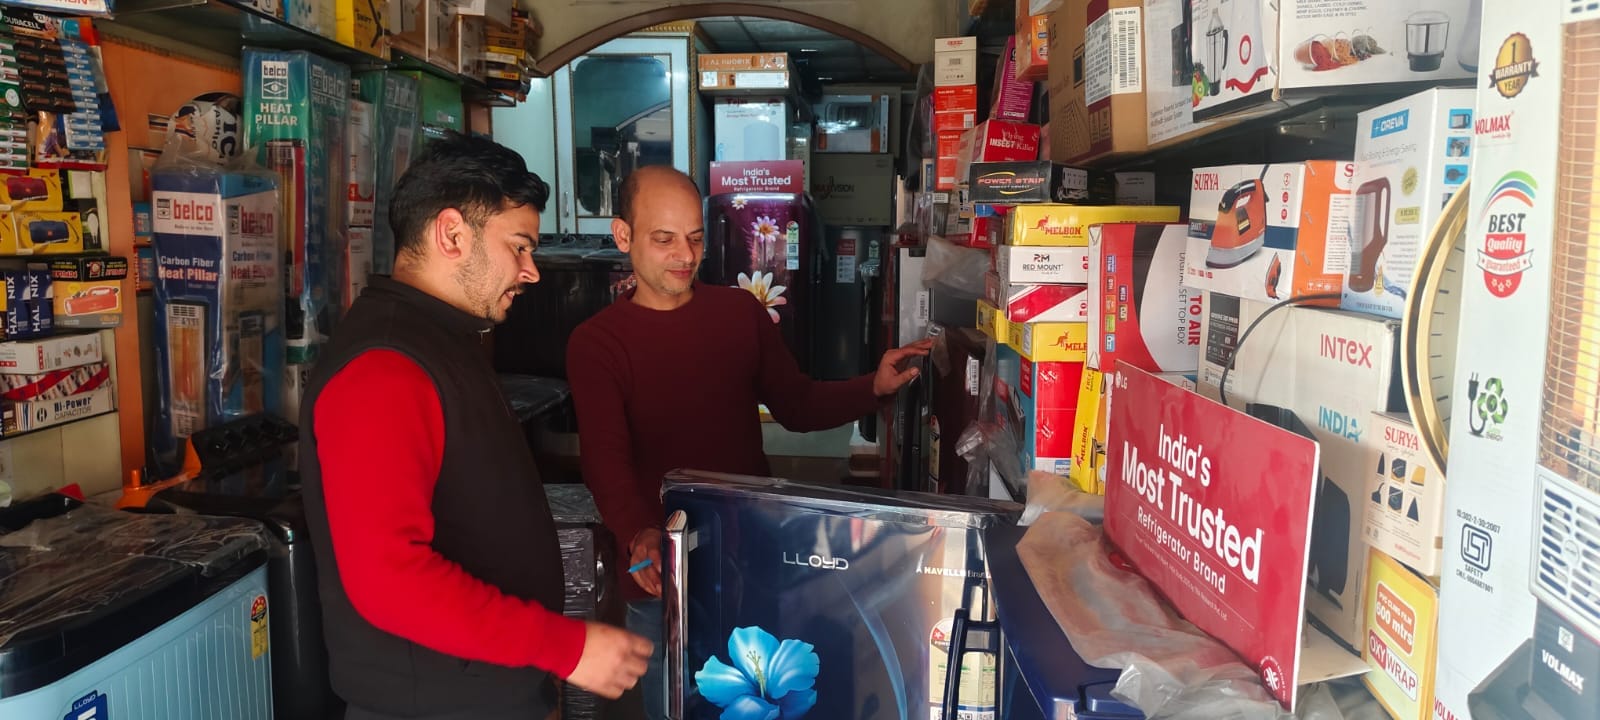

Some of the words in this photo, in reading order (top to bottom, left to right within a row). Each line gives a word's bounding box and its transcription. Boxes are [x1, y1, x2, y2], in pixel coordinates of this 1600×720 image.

[263, 64, 287, 77] belco
[1494, 60, 1533, 79] WARRANTY
[1504, 79, 1521, 91] YEAR
[260, 102, 293, 114] HEAT
[255, 114, 298, 126] PILLAR
[1381, 115, 1404, 131] OREVA
[1475, 114, 1511, 135] VOLMAX
[989, 137, 1016, 149] INSECT
[1016, 143, 1034, 152] Killer
[721, 176, 748, 186] Most
[750, 175, 791, 186] Trusted
[743, 168, 770, 176] India's
[1193, 173, 1219, 191] SURYA
[173, 199, 213, 222] belco
[1045, 226, 1081, 236] MELBON
[1487, 213, 1526, 233] BEST
[1487, 236, 1523, 254] Quality
[160, 255, 191, 267] Carbon
[192, 257, 215, 268] Fiber
[1022, 263, 1035, 271] RED
[1037, 263, 1061, 272] MOUNT
[158, 265, 184, 280] Heat
[187, 267, 218, 282] Pillar
[1178, 288, 1187, 305] SET
[1189, 295, 1203, 316] TO
[1177, 307, 1187, 324] TOP
[1176, 326, 1186, 345] BOX
[1188, 320, 1202, 346] AIR
[54, 396, 92, 412] Hi-Power
[54, 405, 93, 420] CAPACITOR
[1318, 405, 1359, 443] INDIA
[1384, 425, 1420, 451] SURYA
[1158, 423, 1211, 487] India's
[1122, 440, 1166, 511] Most
[1169, 471, 1263, 585] Trusted
[1137, 506, 1191, 564] Refrigerator
[1193, 552, 1226, 594] Brand
[782, 551, 849, 571] LLOYD
[1464, 564, 1484, 579] SAFETY
[1391, 620, 1414, 646] mtrs
[1542, 648, 1585, 691] VOLMAX
[74, 694, 97, 711] LLOYD
